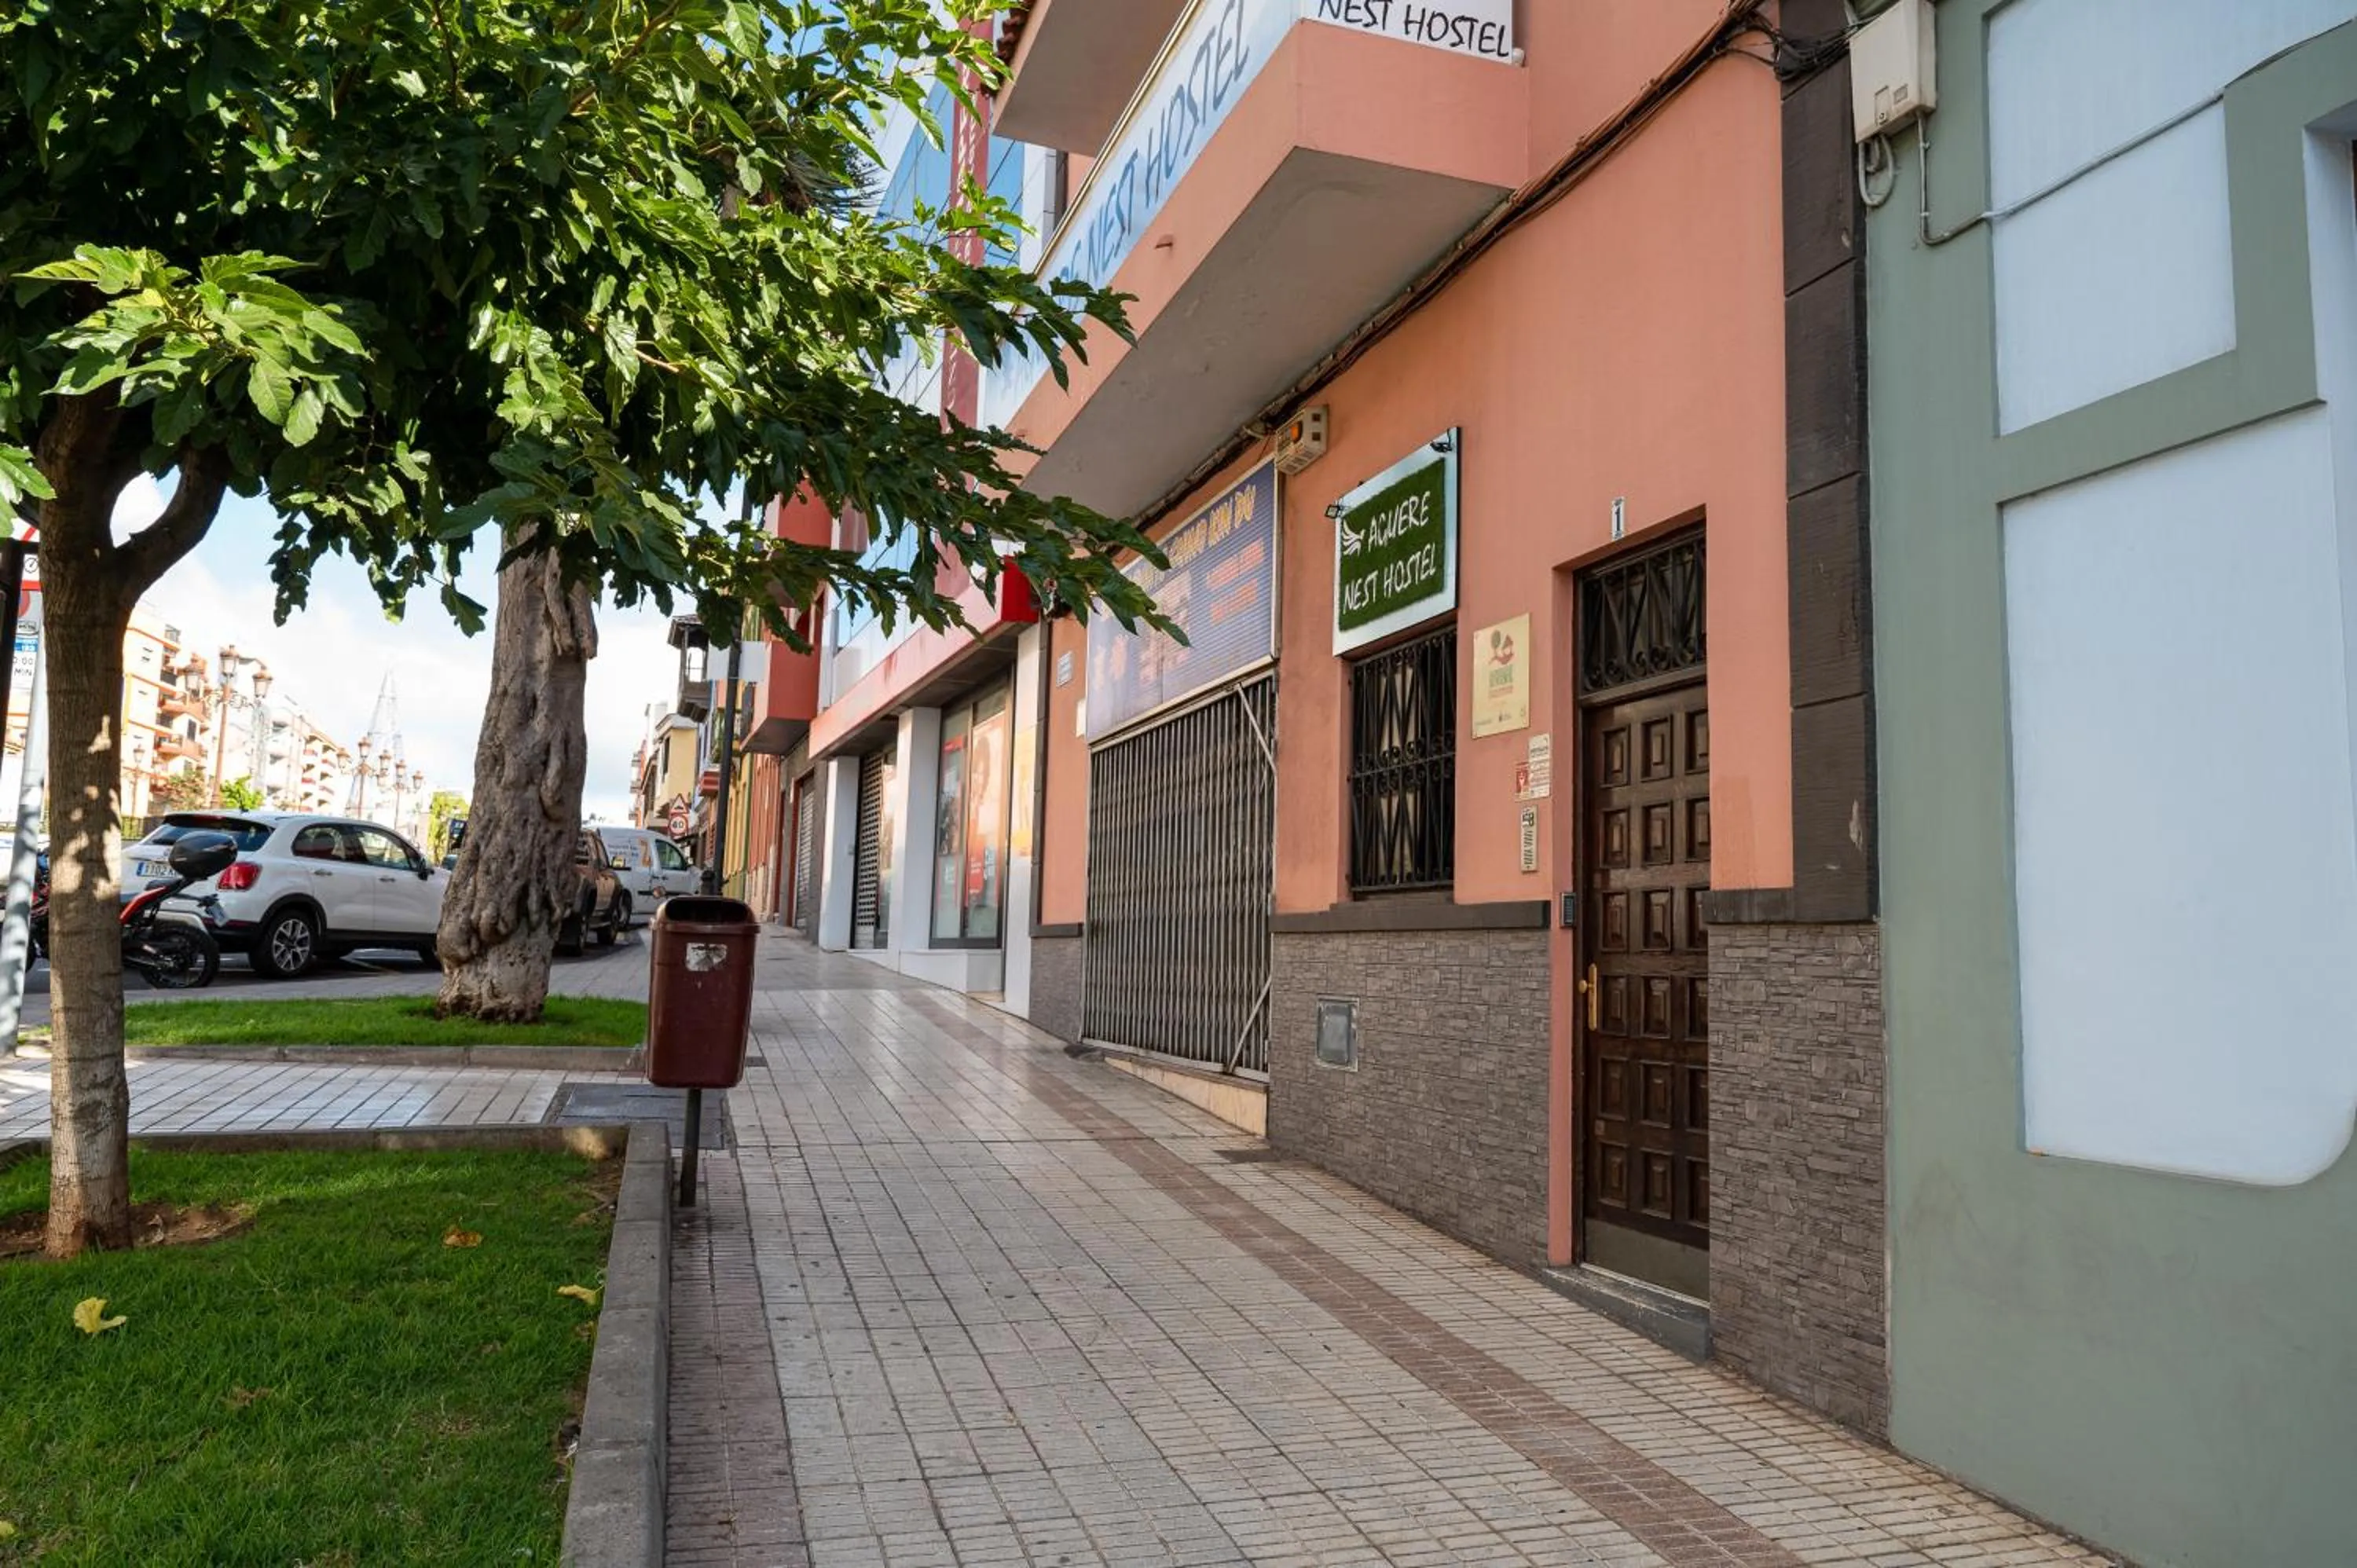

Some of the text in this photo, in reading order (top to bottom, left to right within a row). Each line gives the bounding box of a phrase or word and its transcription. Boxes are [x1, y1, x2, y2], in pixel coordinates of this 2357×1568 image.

[1318, 0, 1509, 57] NEST HOSTEL
[1087, 0, 1250, 284] NEST HOSTEL
[1368, 490, 1431, 552] AGUERE
[1343, 542, 1437, 615] NEST HOSTEL
